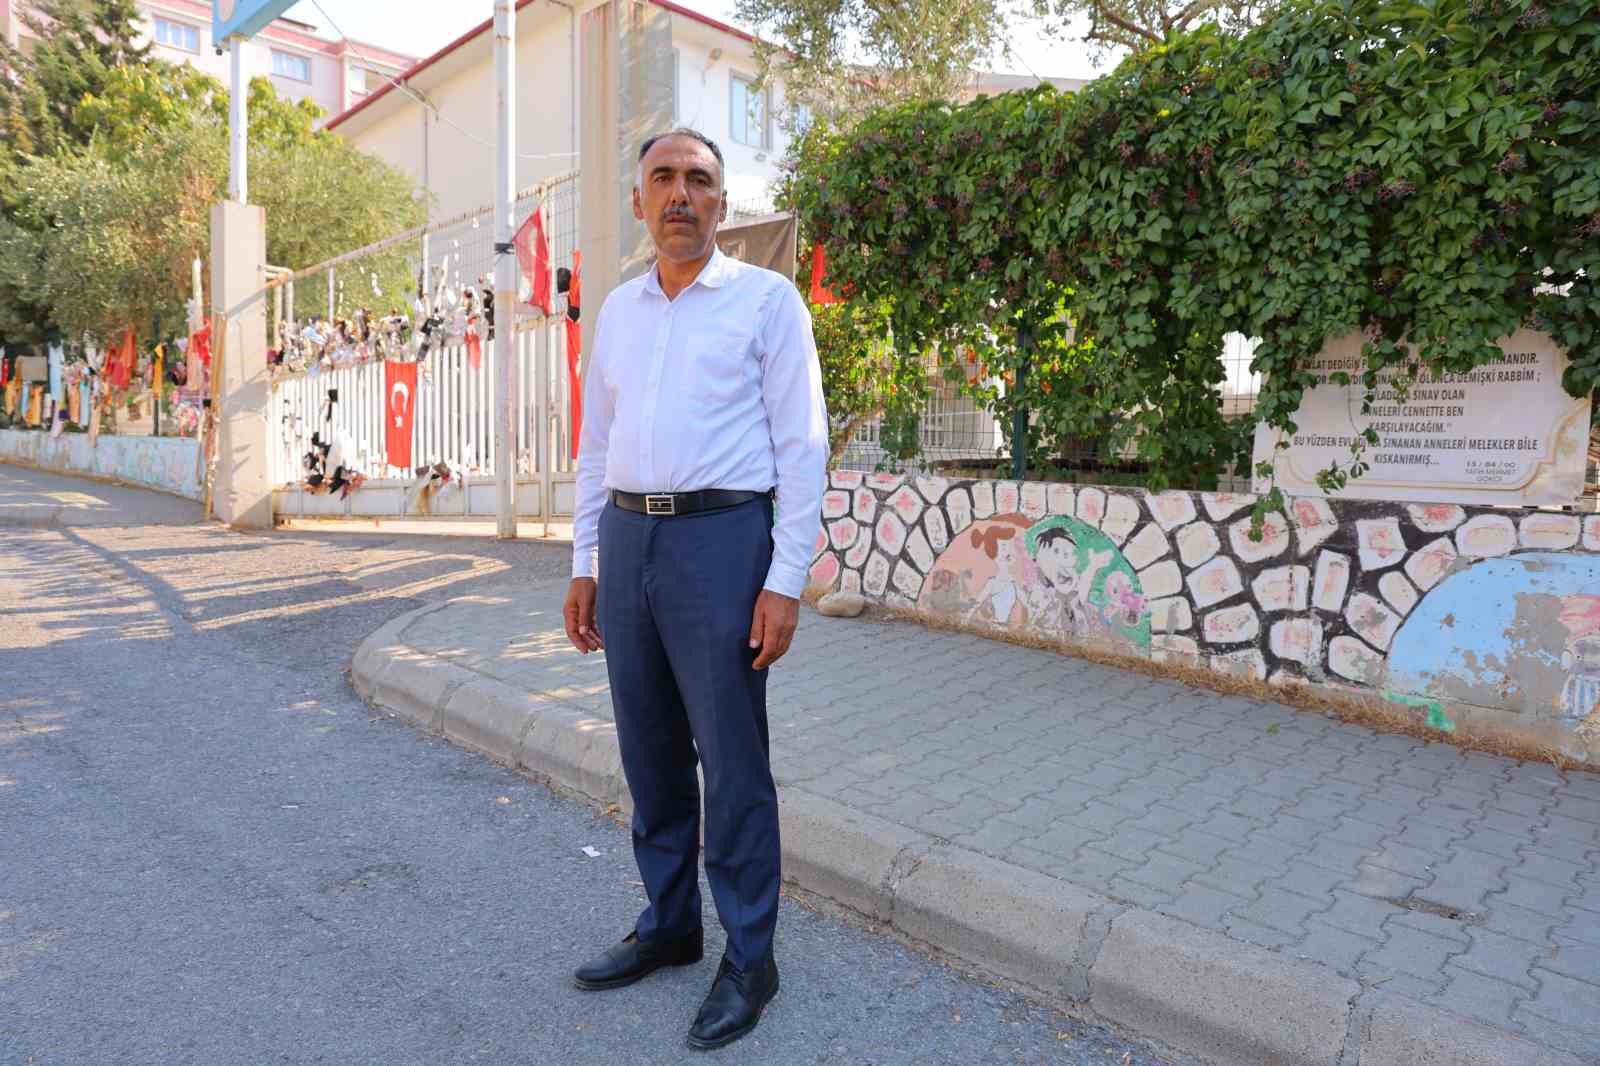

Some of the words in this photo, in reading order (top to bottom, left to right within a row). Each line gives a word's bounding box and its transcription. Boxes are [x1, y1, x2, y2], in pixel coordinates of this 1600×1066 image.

[1497, 367, 1535, 383] RABBİM
[1413, 389, 1439, 401] SINAV
[1440, 388, 1465, 400] OLAN
[1402, 405, 1445, 417] CENNETTE
[1446, 405, 1465, 417] BEN
[1293, 436, 1305, 446] BU
[1306, 433, 1336, 447] YÜZDEN
[1383, 437, 1421, 449] SINANAN
[1424, 436, 1467, 450] ANNELERİ
[1469, 438, 1515, 450] MELEKLER
[1517, 436, 1538, 450] BİLE
